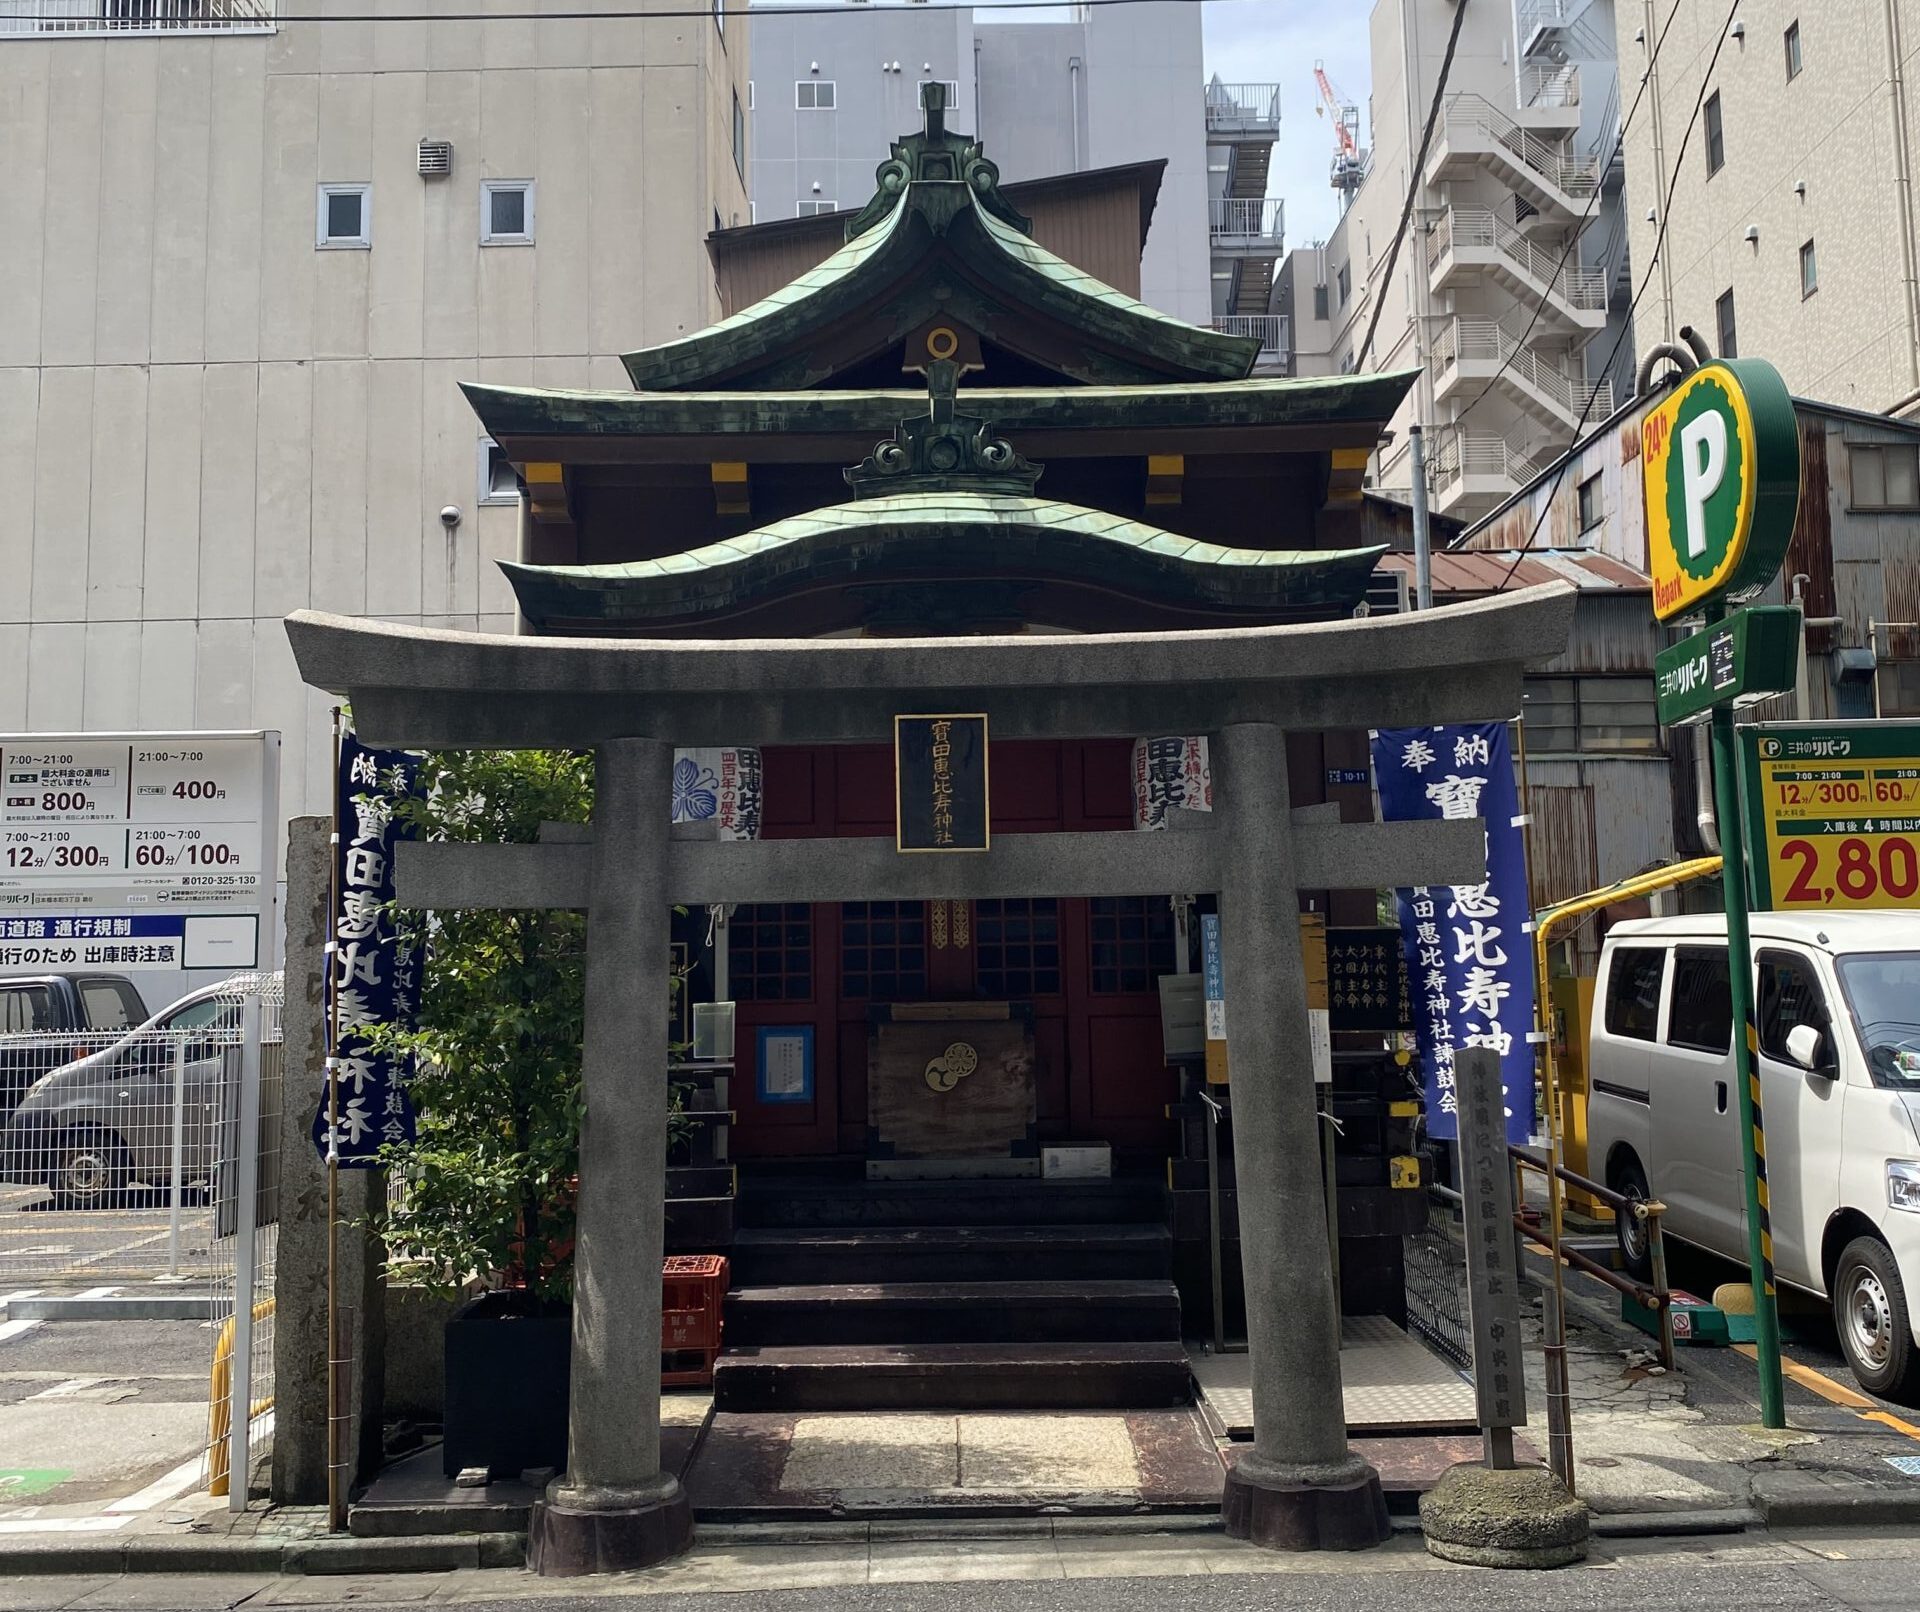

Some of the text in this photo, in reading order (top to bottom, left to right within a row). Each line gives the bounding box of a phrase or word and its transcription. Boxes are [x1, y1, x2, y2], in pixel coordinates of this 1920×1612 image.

[1681, 409, 1728, 559] P
[1655, 572, 1683, 611] Repark
[1660, 654, 1708, 697] 三井のリパーク
[1401, 735, 1488, 774] 奉納
[1787, 740, 1851, 756] 三井のリパーク
[41, 779, 91, 787] ございません
[172, 781, 226, 799] 400円
[720, 752, 737, 829] 四百年の歴史
[42, 792, 95, 811] 800円
[1775, 808, 1806, 816] 最大料金
[1824, 821, 1858, 833] 入庫後
[1864, 819, 1874, 832] 4
[191, 876, 256, 885] 0120-325-130
[54, 918, 131, 937] 通行規制
[84, 945, 175, 963] 出庫時注意
